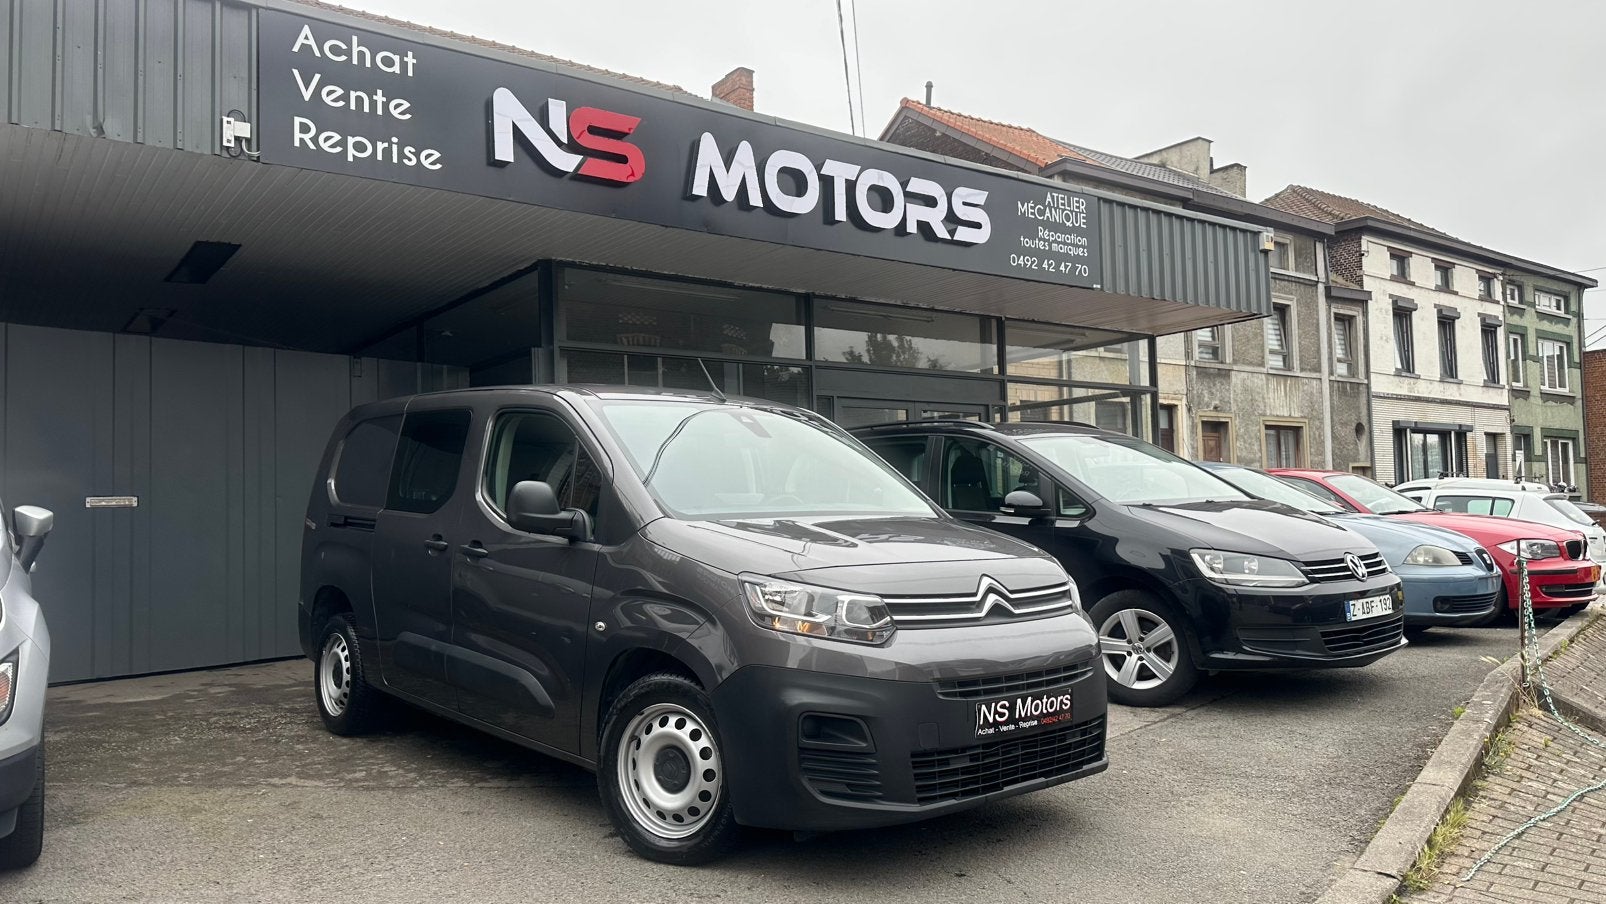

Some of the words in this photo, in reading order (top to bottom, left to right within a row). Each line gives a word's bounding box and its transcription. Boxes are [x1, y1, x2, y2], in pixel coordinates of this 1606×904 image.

[291, 24, 417, 78] Achat
[291, 68, 413, 121] Vente
[292, 116, 443, 171] Reprise
[490, 86, 647, 184] NS
[691, 131, 992, 245] MOTORS
[1017, 200, 1087, 229] MÉCANIQUE
[1045, 191, 1087, 213] ATELIER
[1020, 235, 1049, 251] toutes
[1051, 242, 1088, 257] marques
[1038, 226, 1088, 246] Réparation
[1010, 253, 1039, 270] 0492
[1042, 259, 1056, 272] 42
[1059, 261, 1072, 274] 47
[1075, 263, 1089, 277] 70
[979, 700, 1010, 725] NS
[1015, 694, 1071, 719] Motors
[977, 727, 995, 735] Achat
[998, 723, 1016, 732] Vente
[1018, 719, 1038, 729] Reprise
